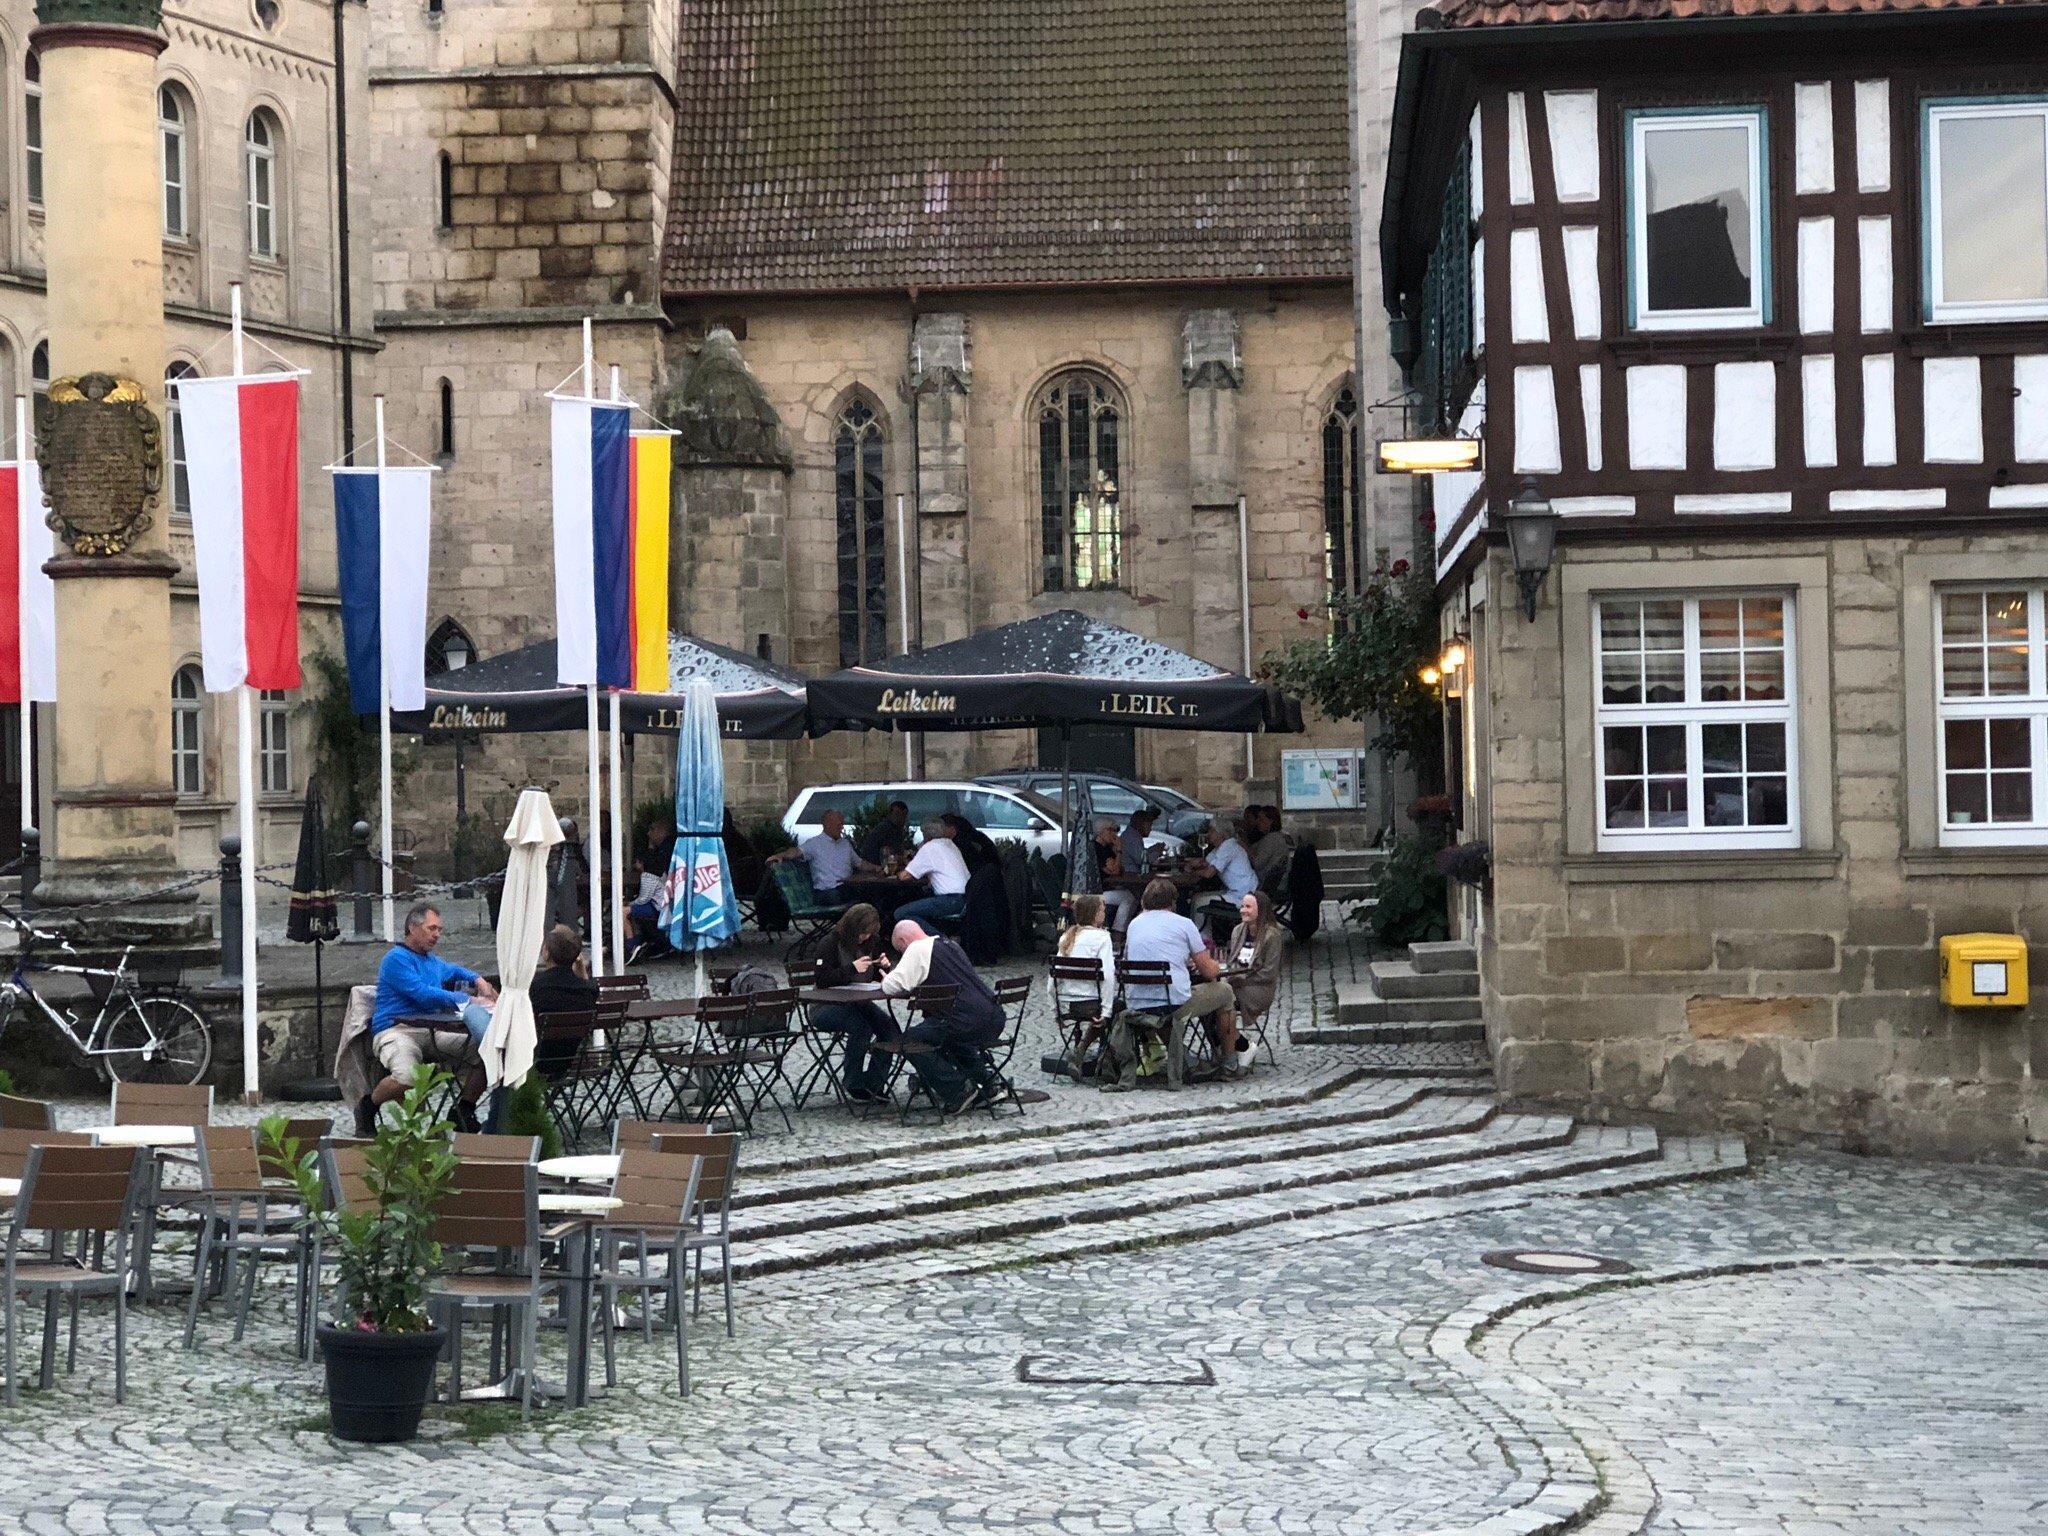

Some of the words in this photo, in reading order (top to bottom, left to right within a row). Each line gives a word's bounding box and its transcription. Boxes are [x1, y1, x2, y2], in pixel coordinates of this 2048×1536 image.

[878, 688, 956, 713] Leikeim
[1111, 693, 1175, 716] LEIK
[1181, 704, 1199, 716] IT.
[429, 703, 507, 728] Leikeim
[725, 719, 743, 732] IT.
